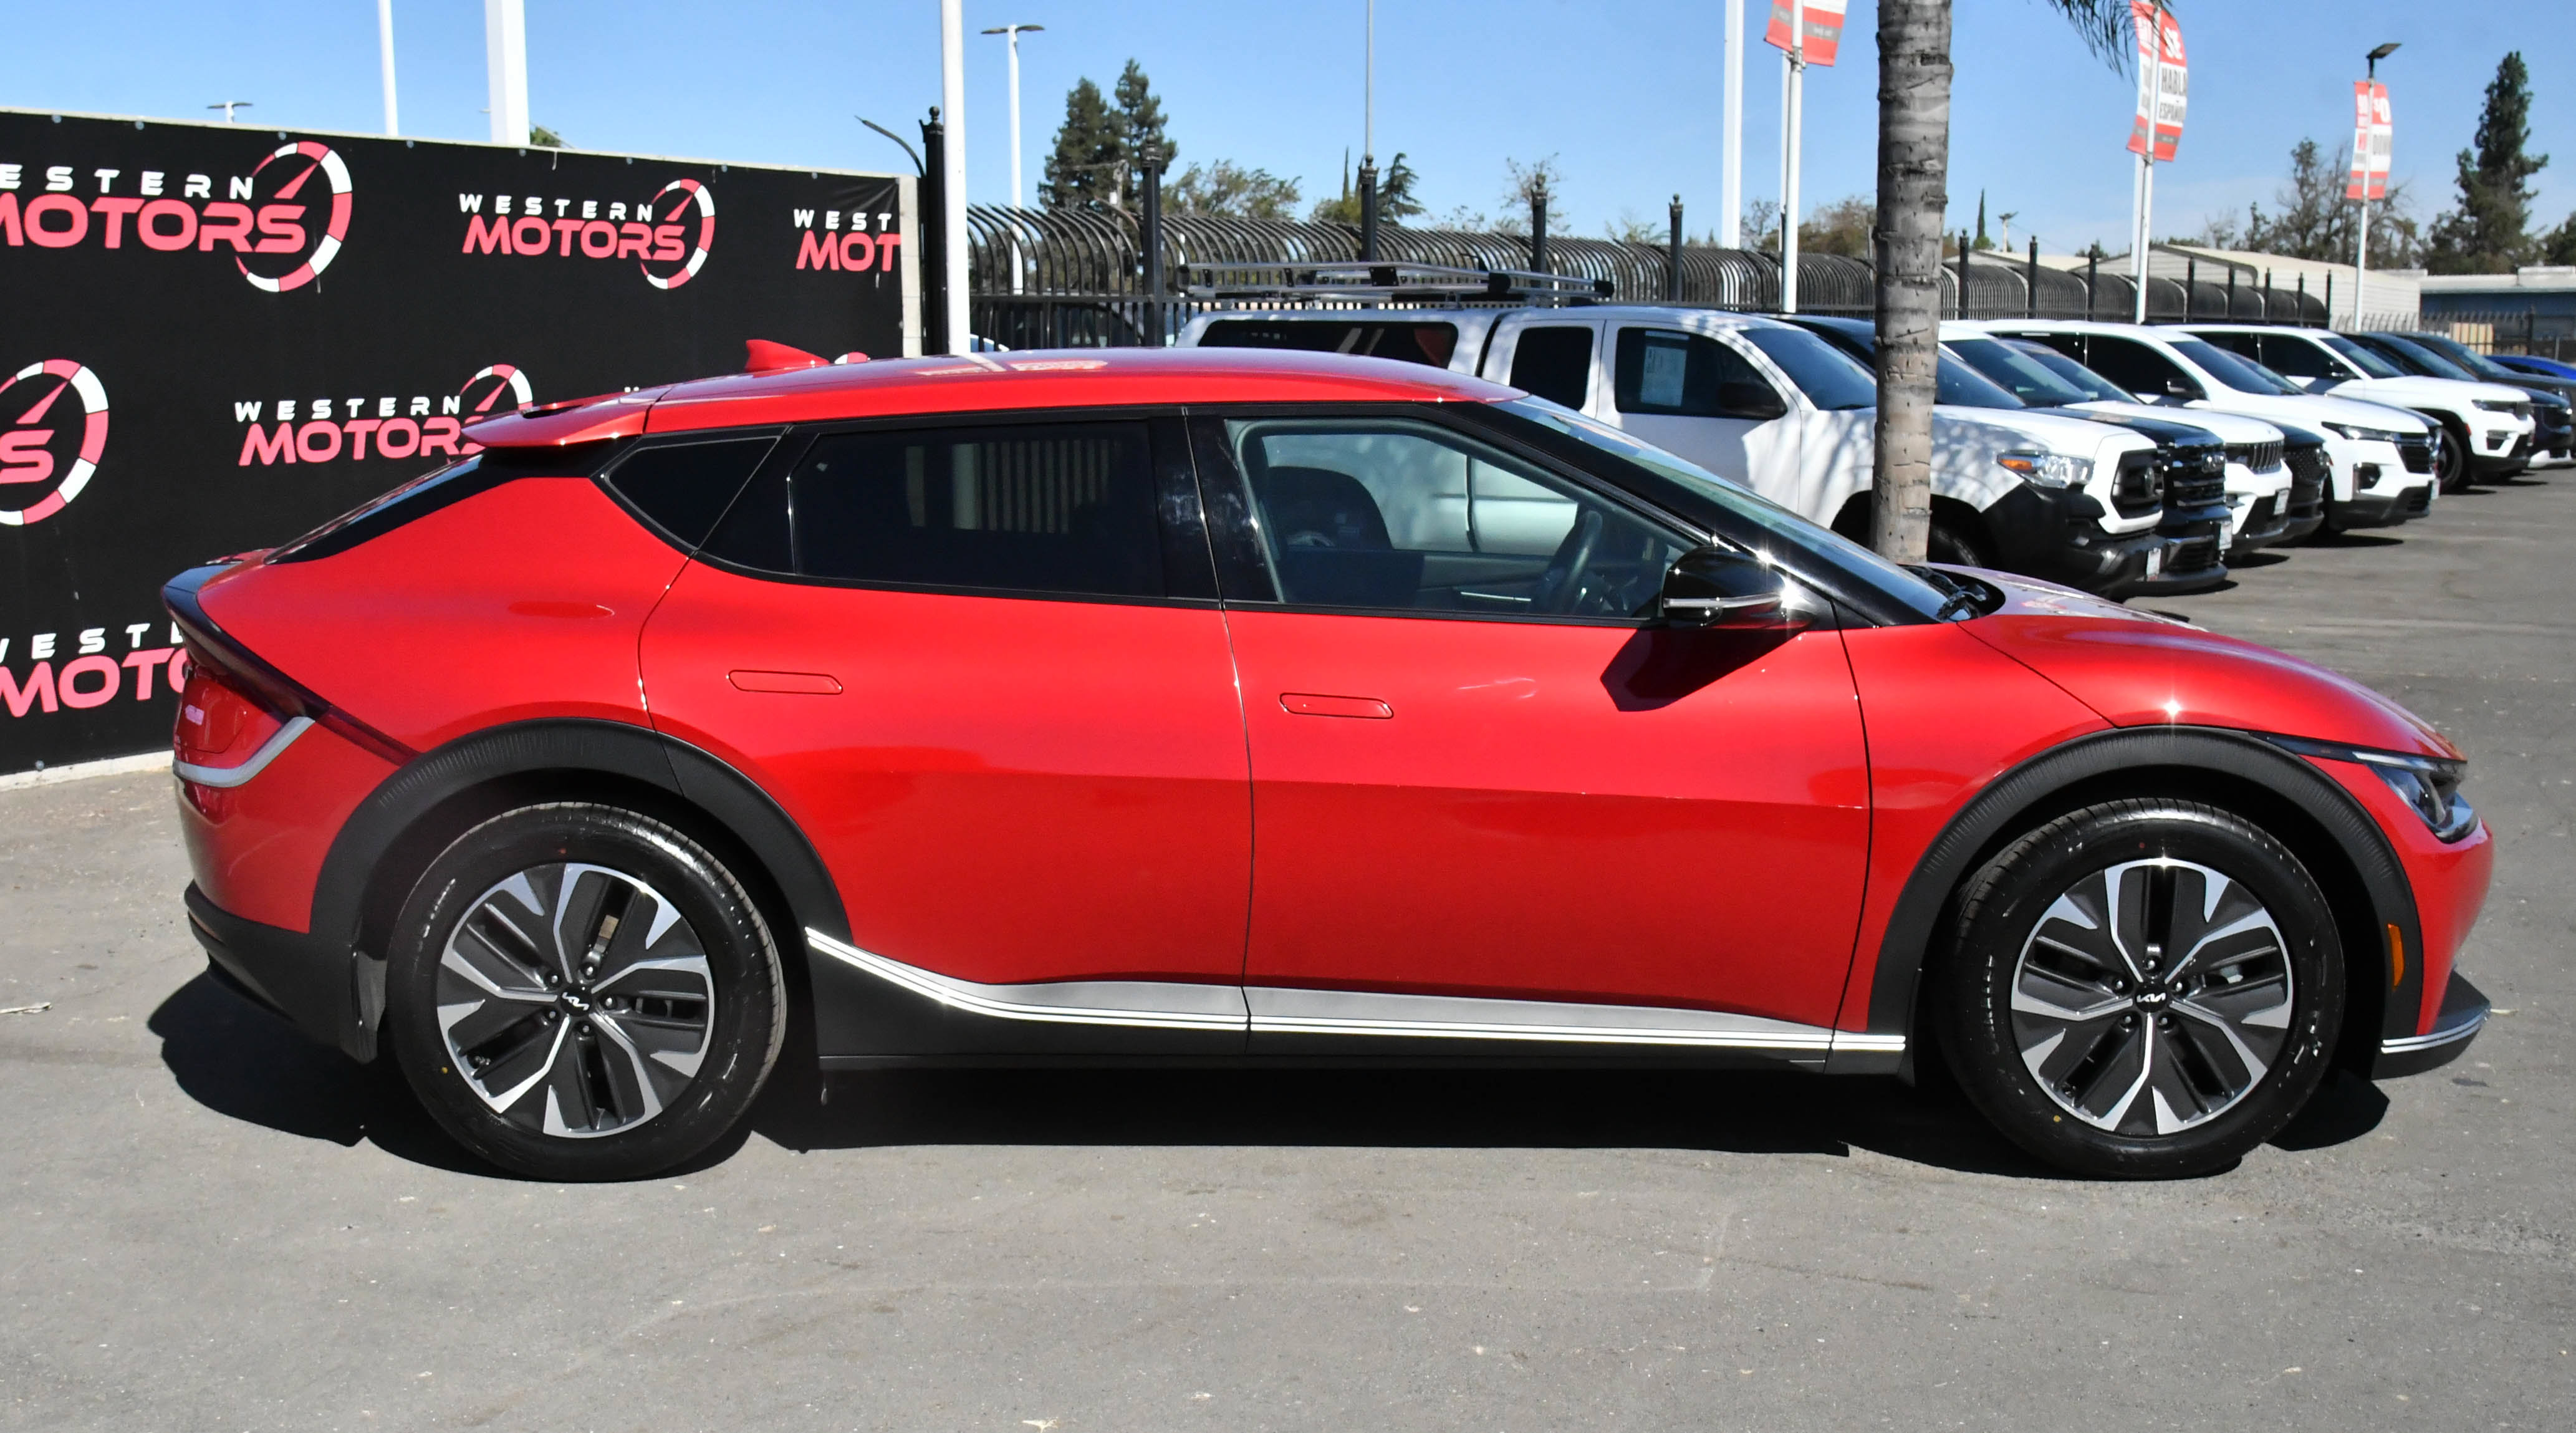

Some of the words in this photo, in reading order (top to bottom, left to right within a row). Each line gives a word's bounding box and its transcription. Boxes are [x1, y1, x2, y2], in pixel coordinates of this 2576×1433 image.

[459, 193, 653, 222] WESTERN
[794, 208, 892, 231] WEST
[462, 215, 685, 261] MOTORS
[795, 229, 901, 272] MOT
[234, 395, 461, 422] WESTERN
[0, 621, 183, 661] EST
